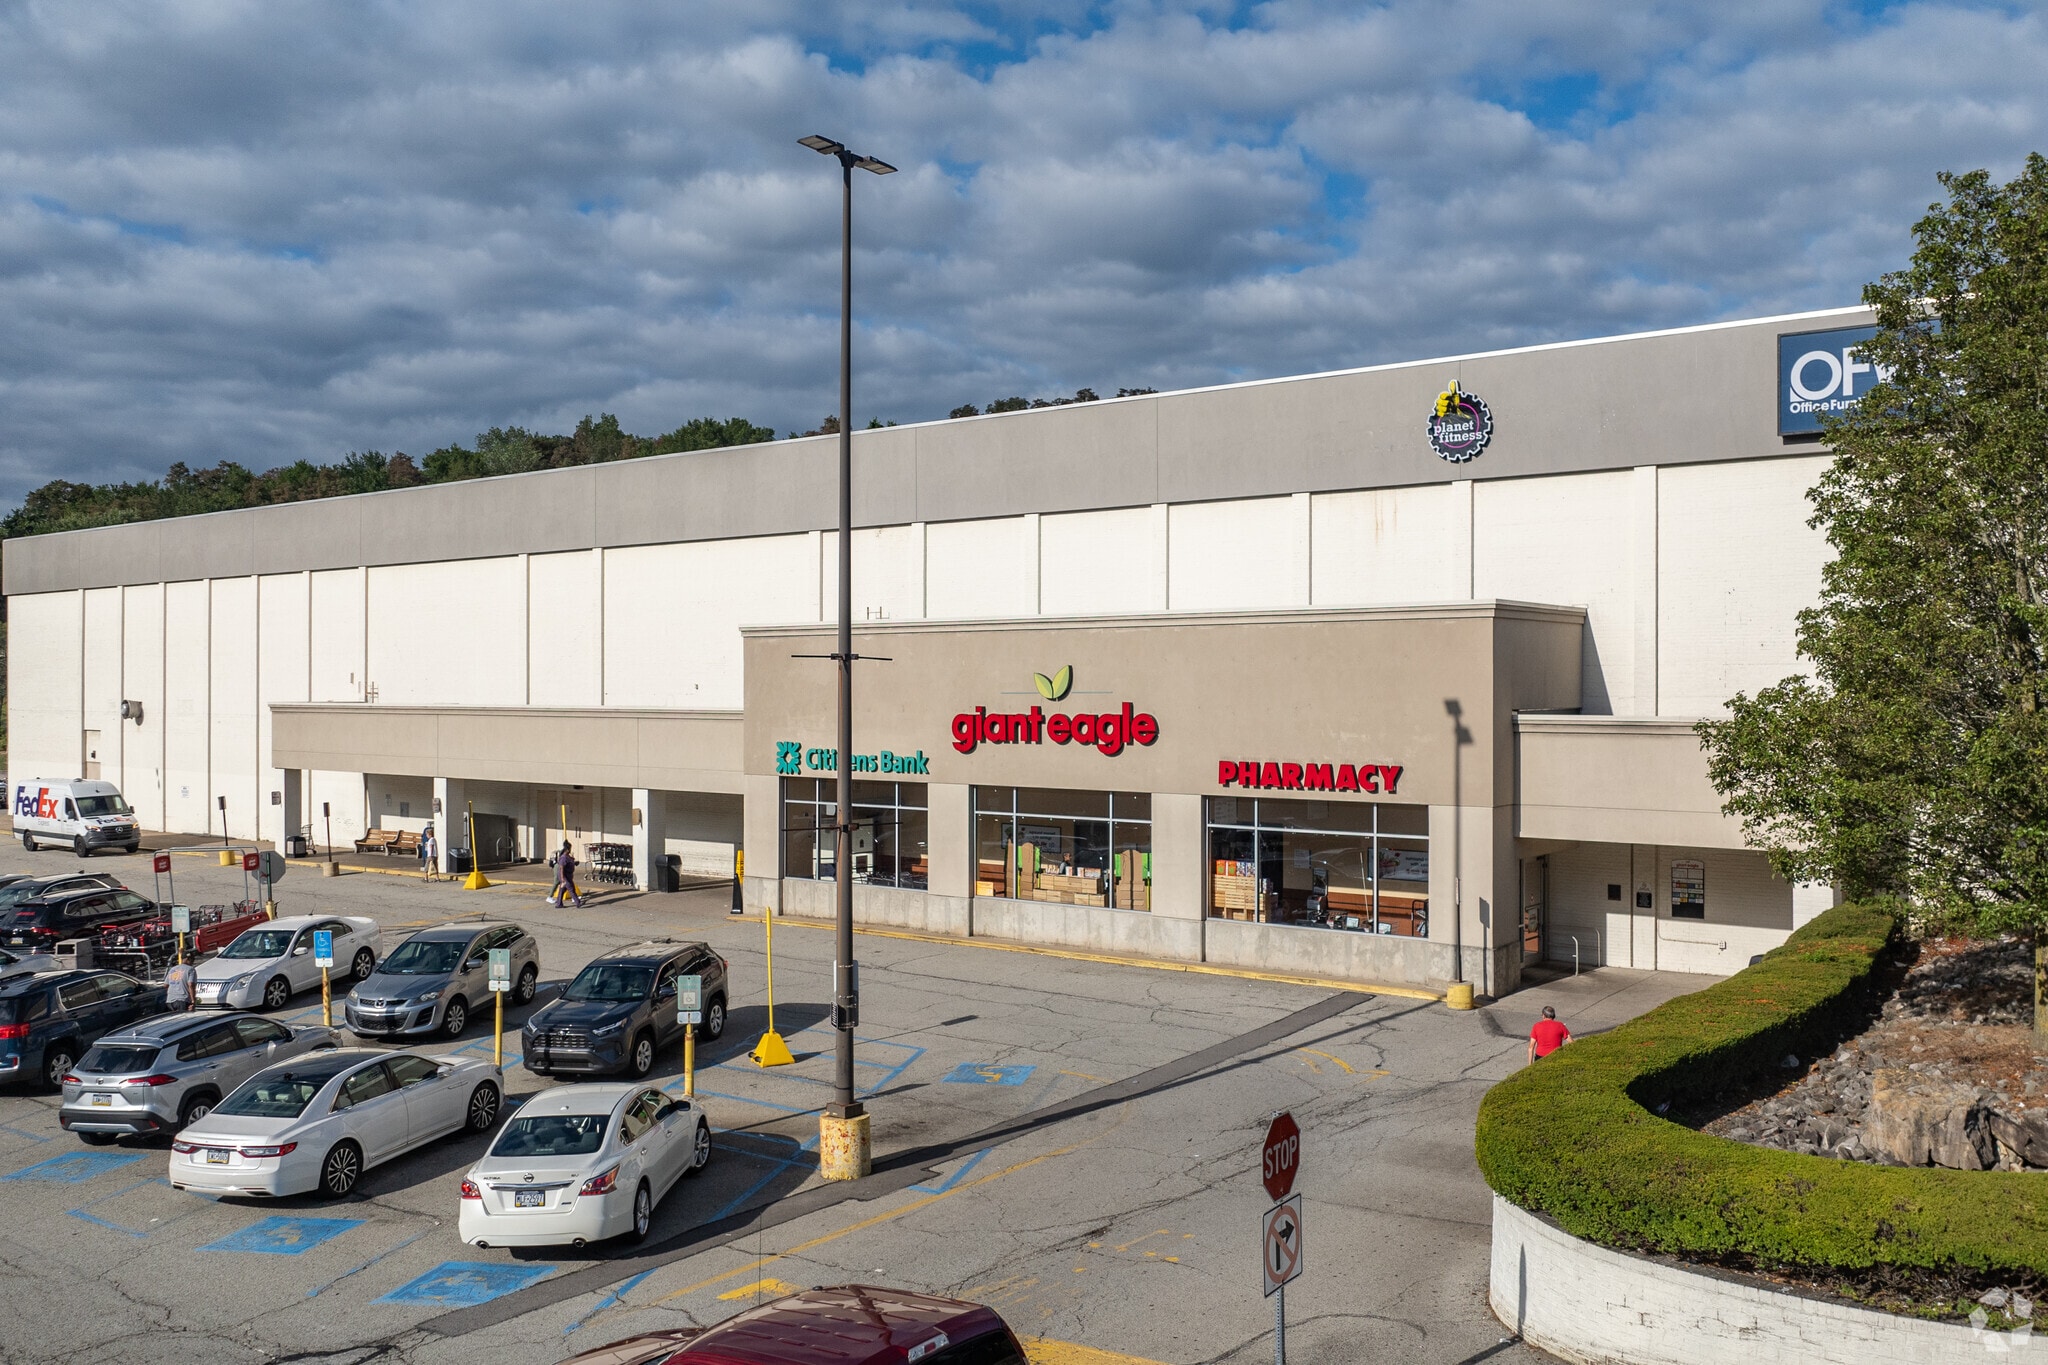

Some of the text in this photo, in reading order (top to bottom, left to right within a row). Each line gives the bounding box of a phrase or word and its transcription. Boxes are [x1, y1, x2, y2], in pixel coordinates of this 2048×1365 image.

[1789, 401, 1830, 414] Office
[1433, 420, 1475, 437] planet
[1439, 431, 1483, 444] fitness
[952, 702, 1159, 756] giant eagle
[805, 748, 929, 774] Citiens Bank
[1219, 761, 1402, 793] PHARMACY
[15, 786, 59, 819] FedEx
[97, 816, 131, 825] FedEx
[1265, 1135, 1298, 1180] STOP
